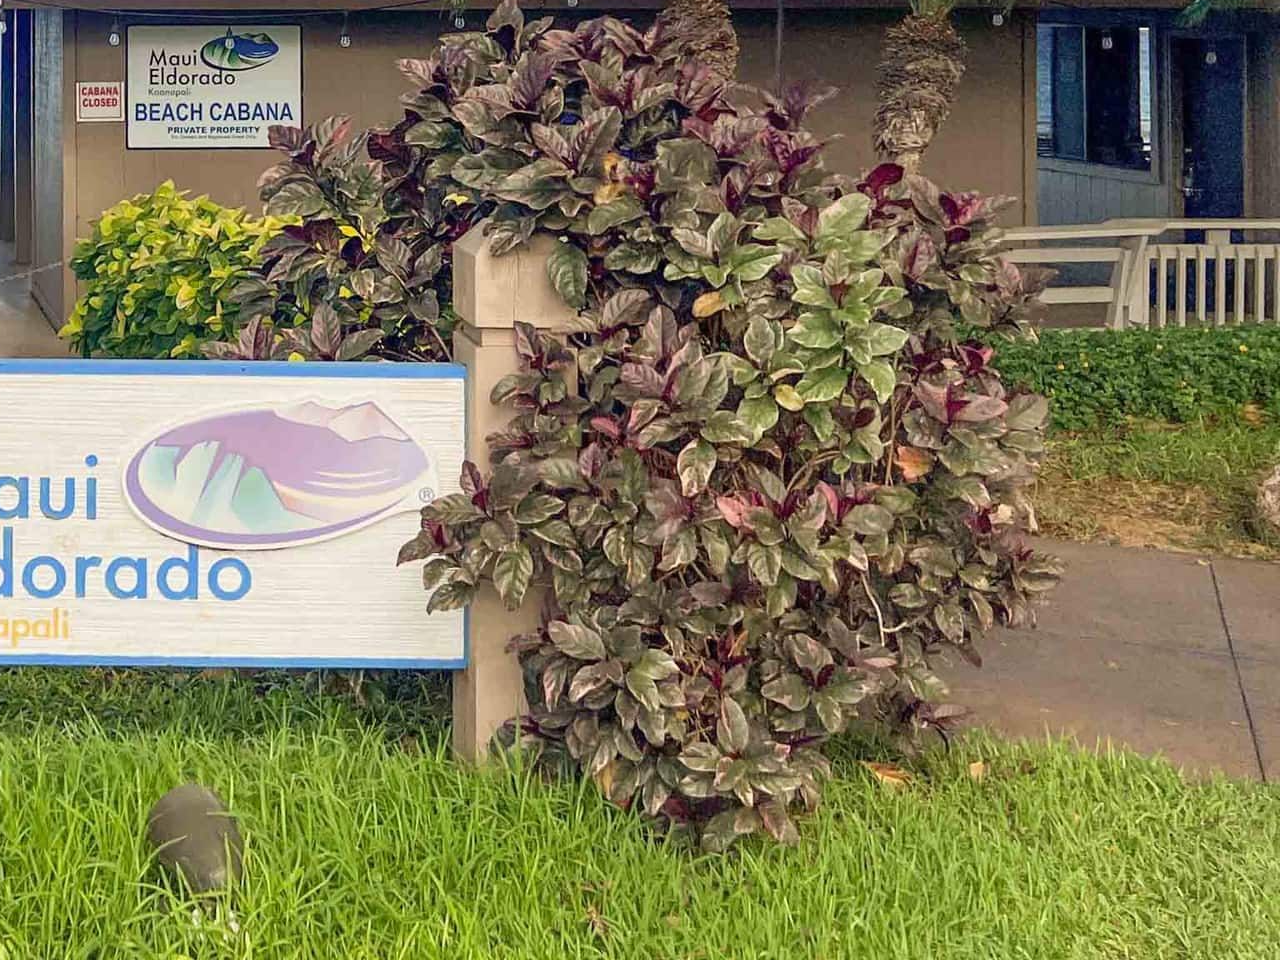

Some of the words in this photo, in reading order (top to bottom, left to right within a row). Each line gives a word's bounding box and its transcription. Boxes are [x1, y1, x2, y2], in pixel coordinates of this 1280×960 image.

[149, 49, 197, 66] Maui
[149, 67, 236, 86] Eldorado
[81, 86, 119, 96] CABANA
[82, 98, 118, 107] CLOSED
[135, 103, 203, 122] BEACH
[209, 102, 294, 122] CABANA
[167, 126, 208, 135] PRIVATE
[210, 126, 260, 134] PROPERTY
